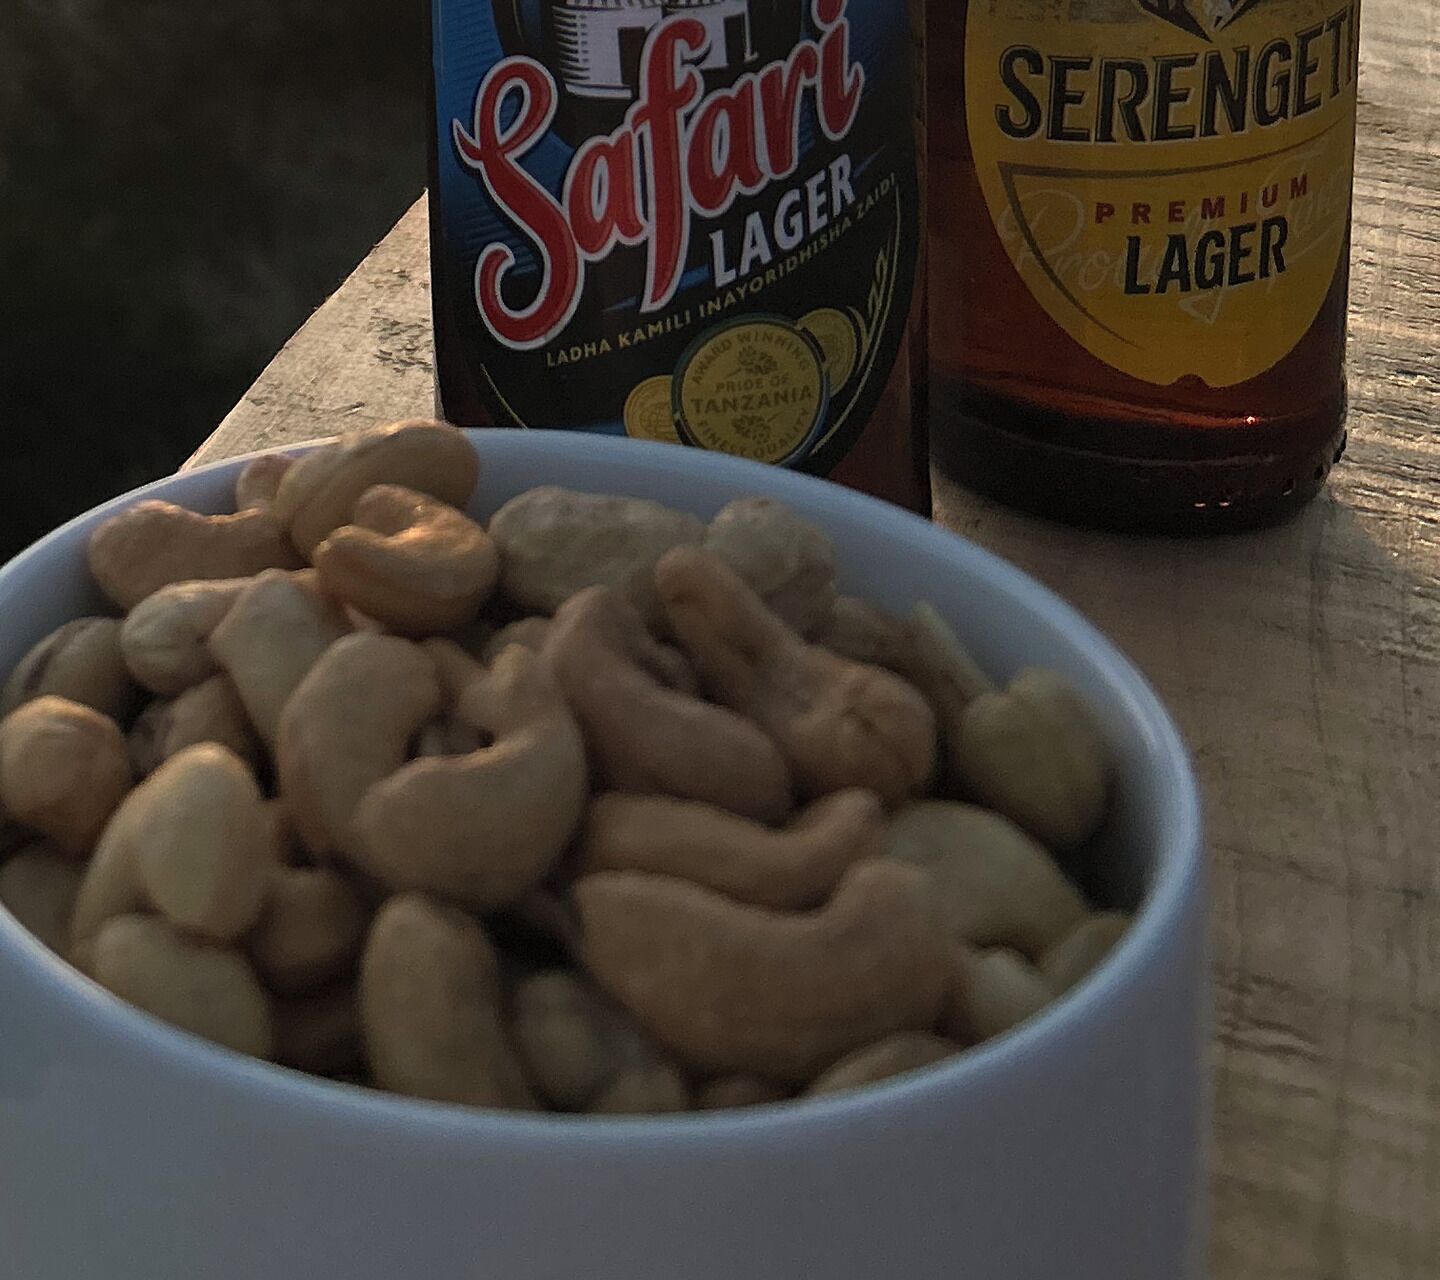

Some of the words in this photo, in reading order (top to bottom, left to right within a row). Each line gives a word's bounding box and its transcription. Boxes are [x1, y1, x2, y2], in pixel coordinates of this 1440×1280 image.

[710, 152, 857, 289] LAGER
[1094, 173, 1309, 225] PREMIUM
[546, 339, 612, 368] LADHA
[618, 307, 692, 349] KAMILI
[699, 216, 853, 319] INAYORIDHISHA
[856, 171, 896, 220] ZAIDI
[1123, 215, 1288, 295] LAGER
[692, 339, 733, 385] AWARD
[736, 331, 809, 372] WINNING
[715, 376, 765, 394] PRIDE
[769, 373, 790, 387] OF
[689, 384, 814, 415] TANZANIA
